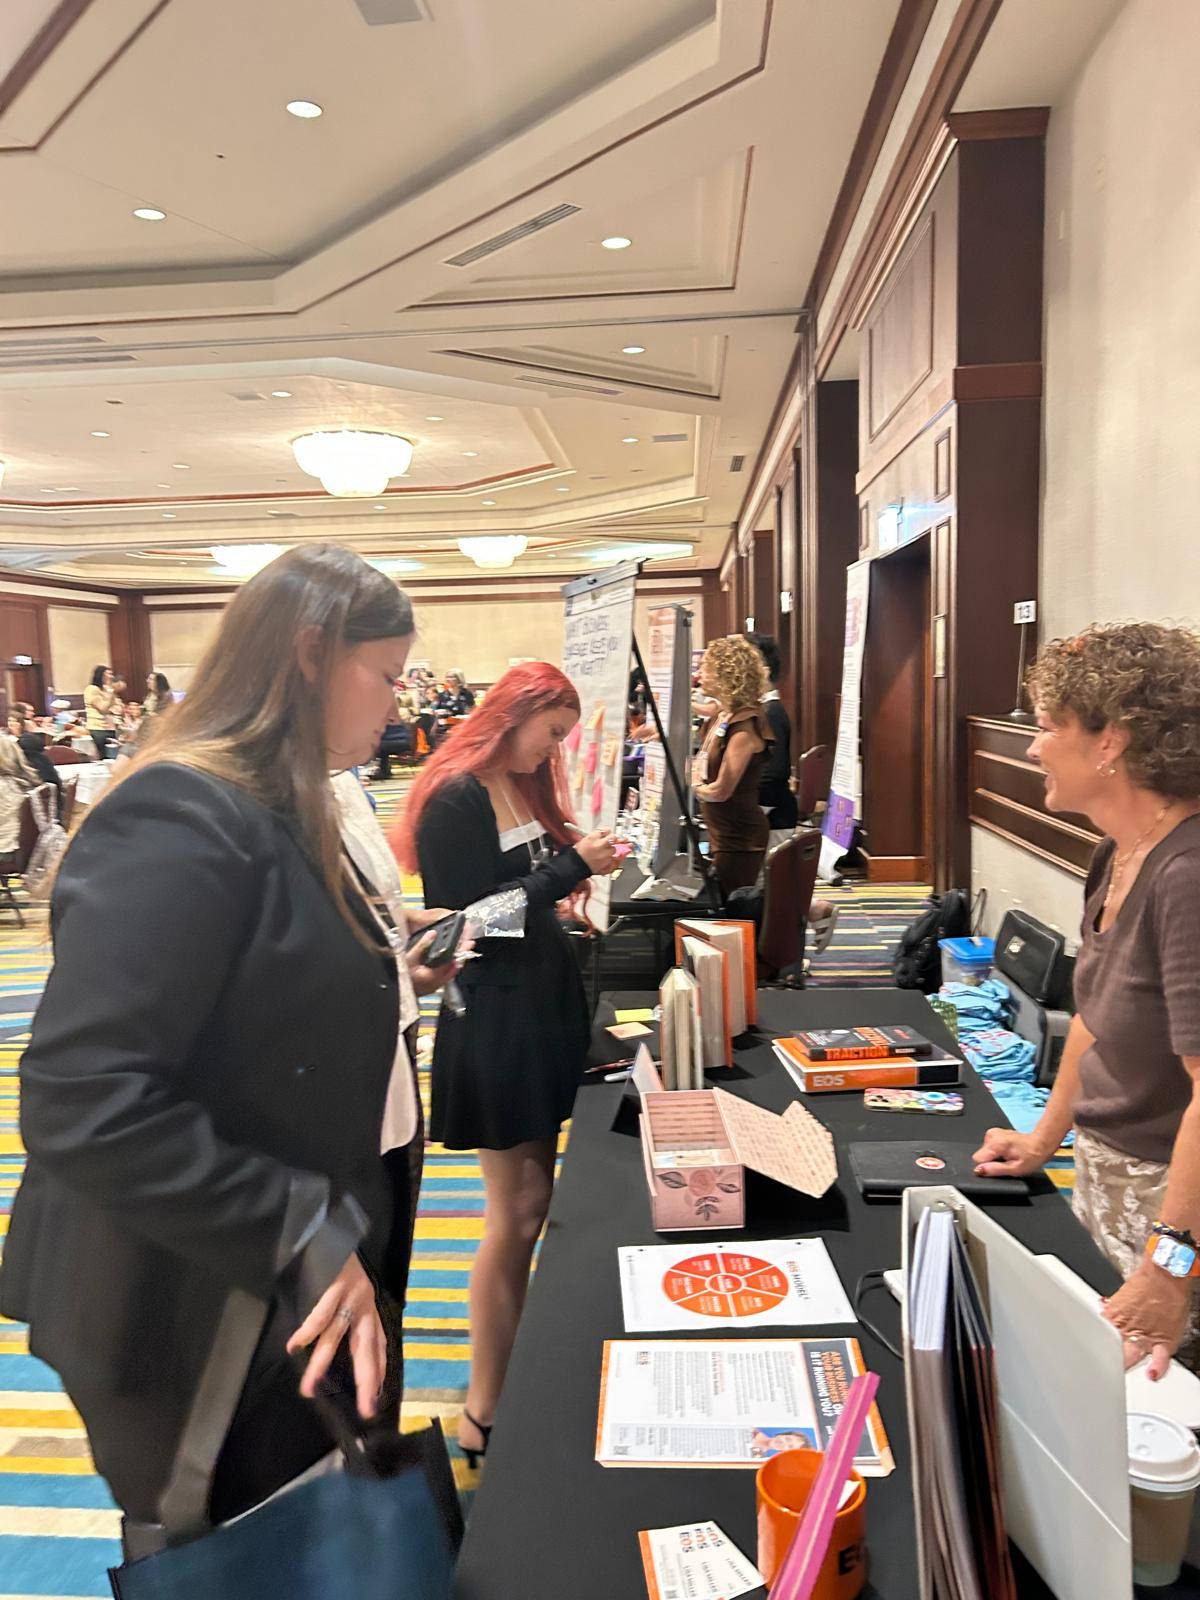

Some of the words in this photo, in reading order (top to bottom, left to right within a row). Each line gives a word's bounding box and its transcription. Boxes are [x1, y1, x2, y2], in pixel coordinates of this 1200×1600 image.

[825, 1046, 889, 1060] TRACTION
[812, 1074, 846, 1088] EOS
[680, 1531, 695, 1553] EOS
